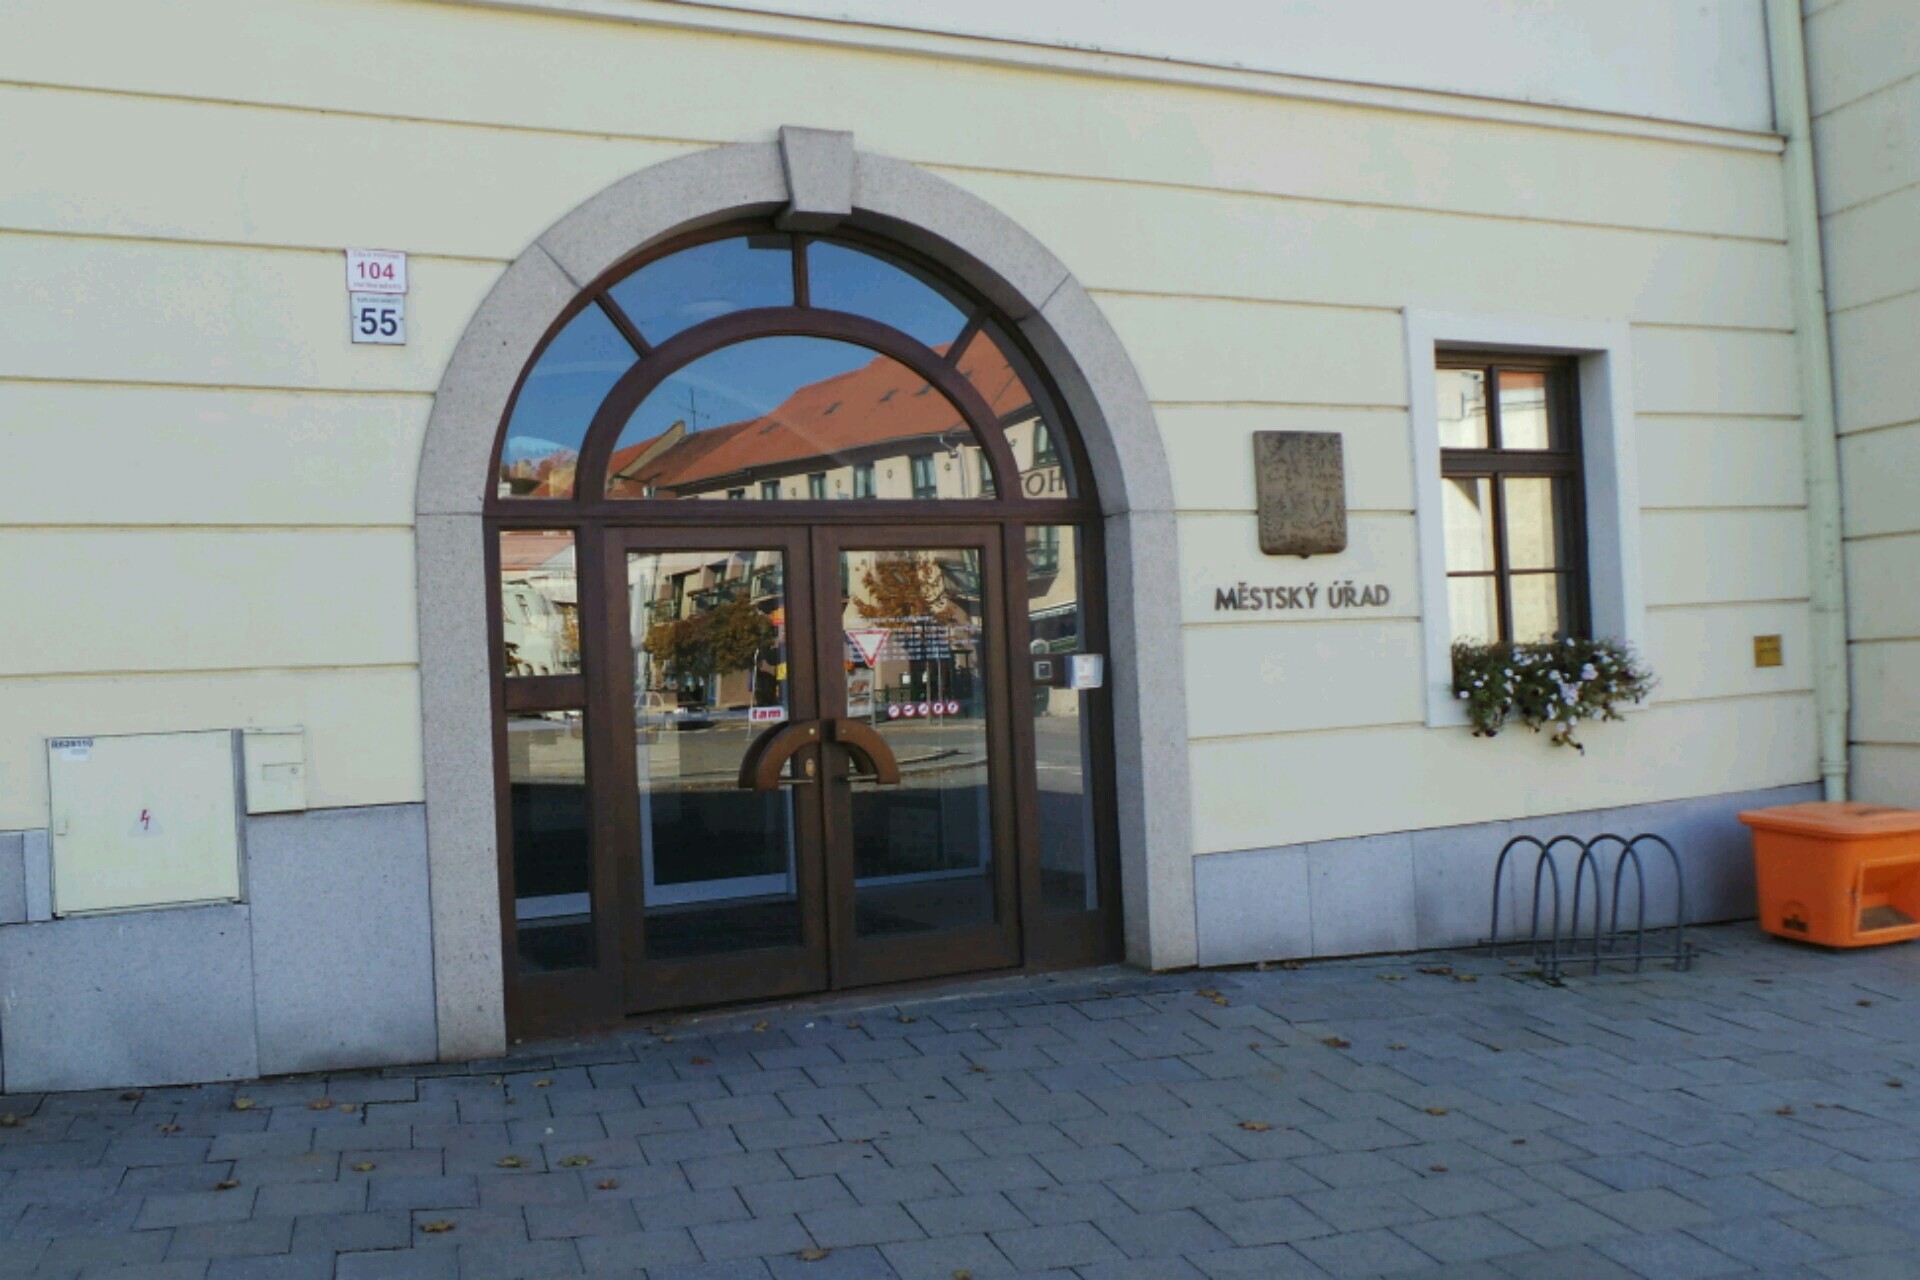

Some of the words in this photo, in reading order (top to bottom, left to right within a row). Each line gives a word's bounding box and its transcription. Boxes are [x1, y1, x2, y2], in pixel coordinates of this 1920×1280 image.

[356, 260, 395, 280] 104
[360, 307, 398, 336] 55
[1215, 582, 1319, 611] MĚSTSKÝ
[1327, 580, 1390, 609] ÚŘAD
